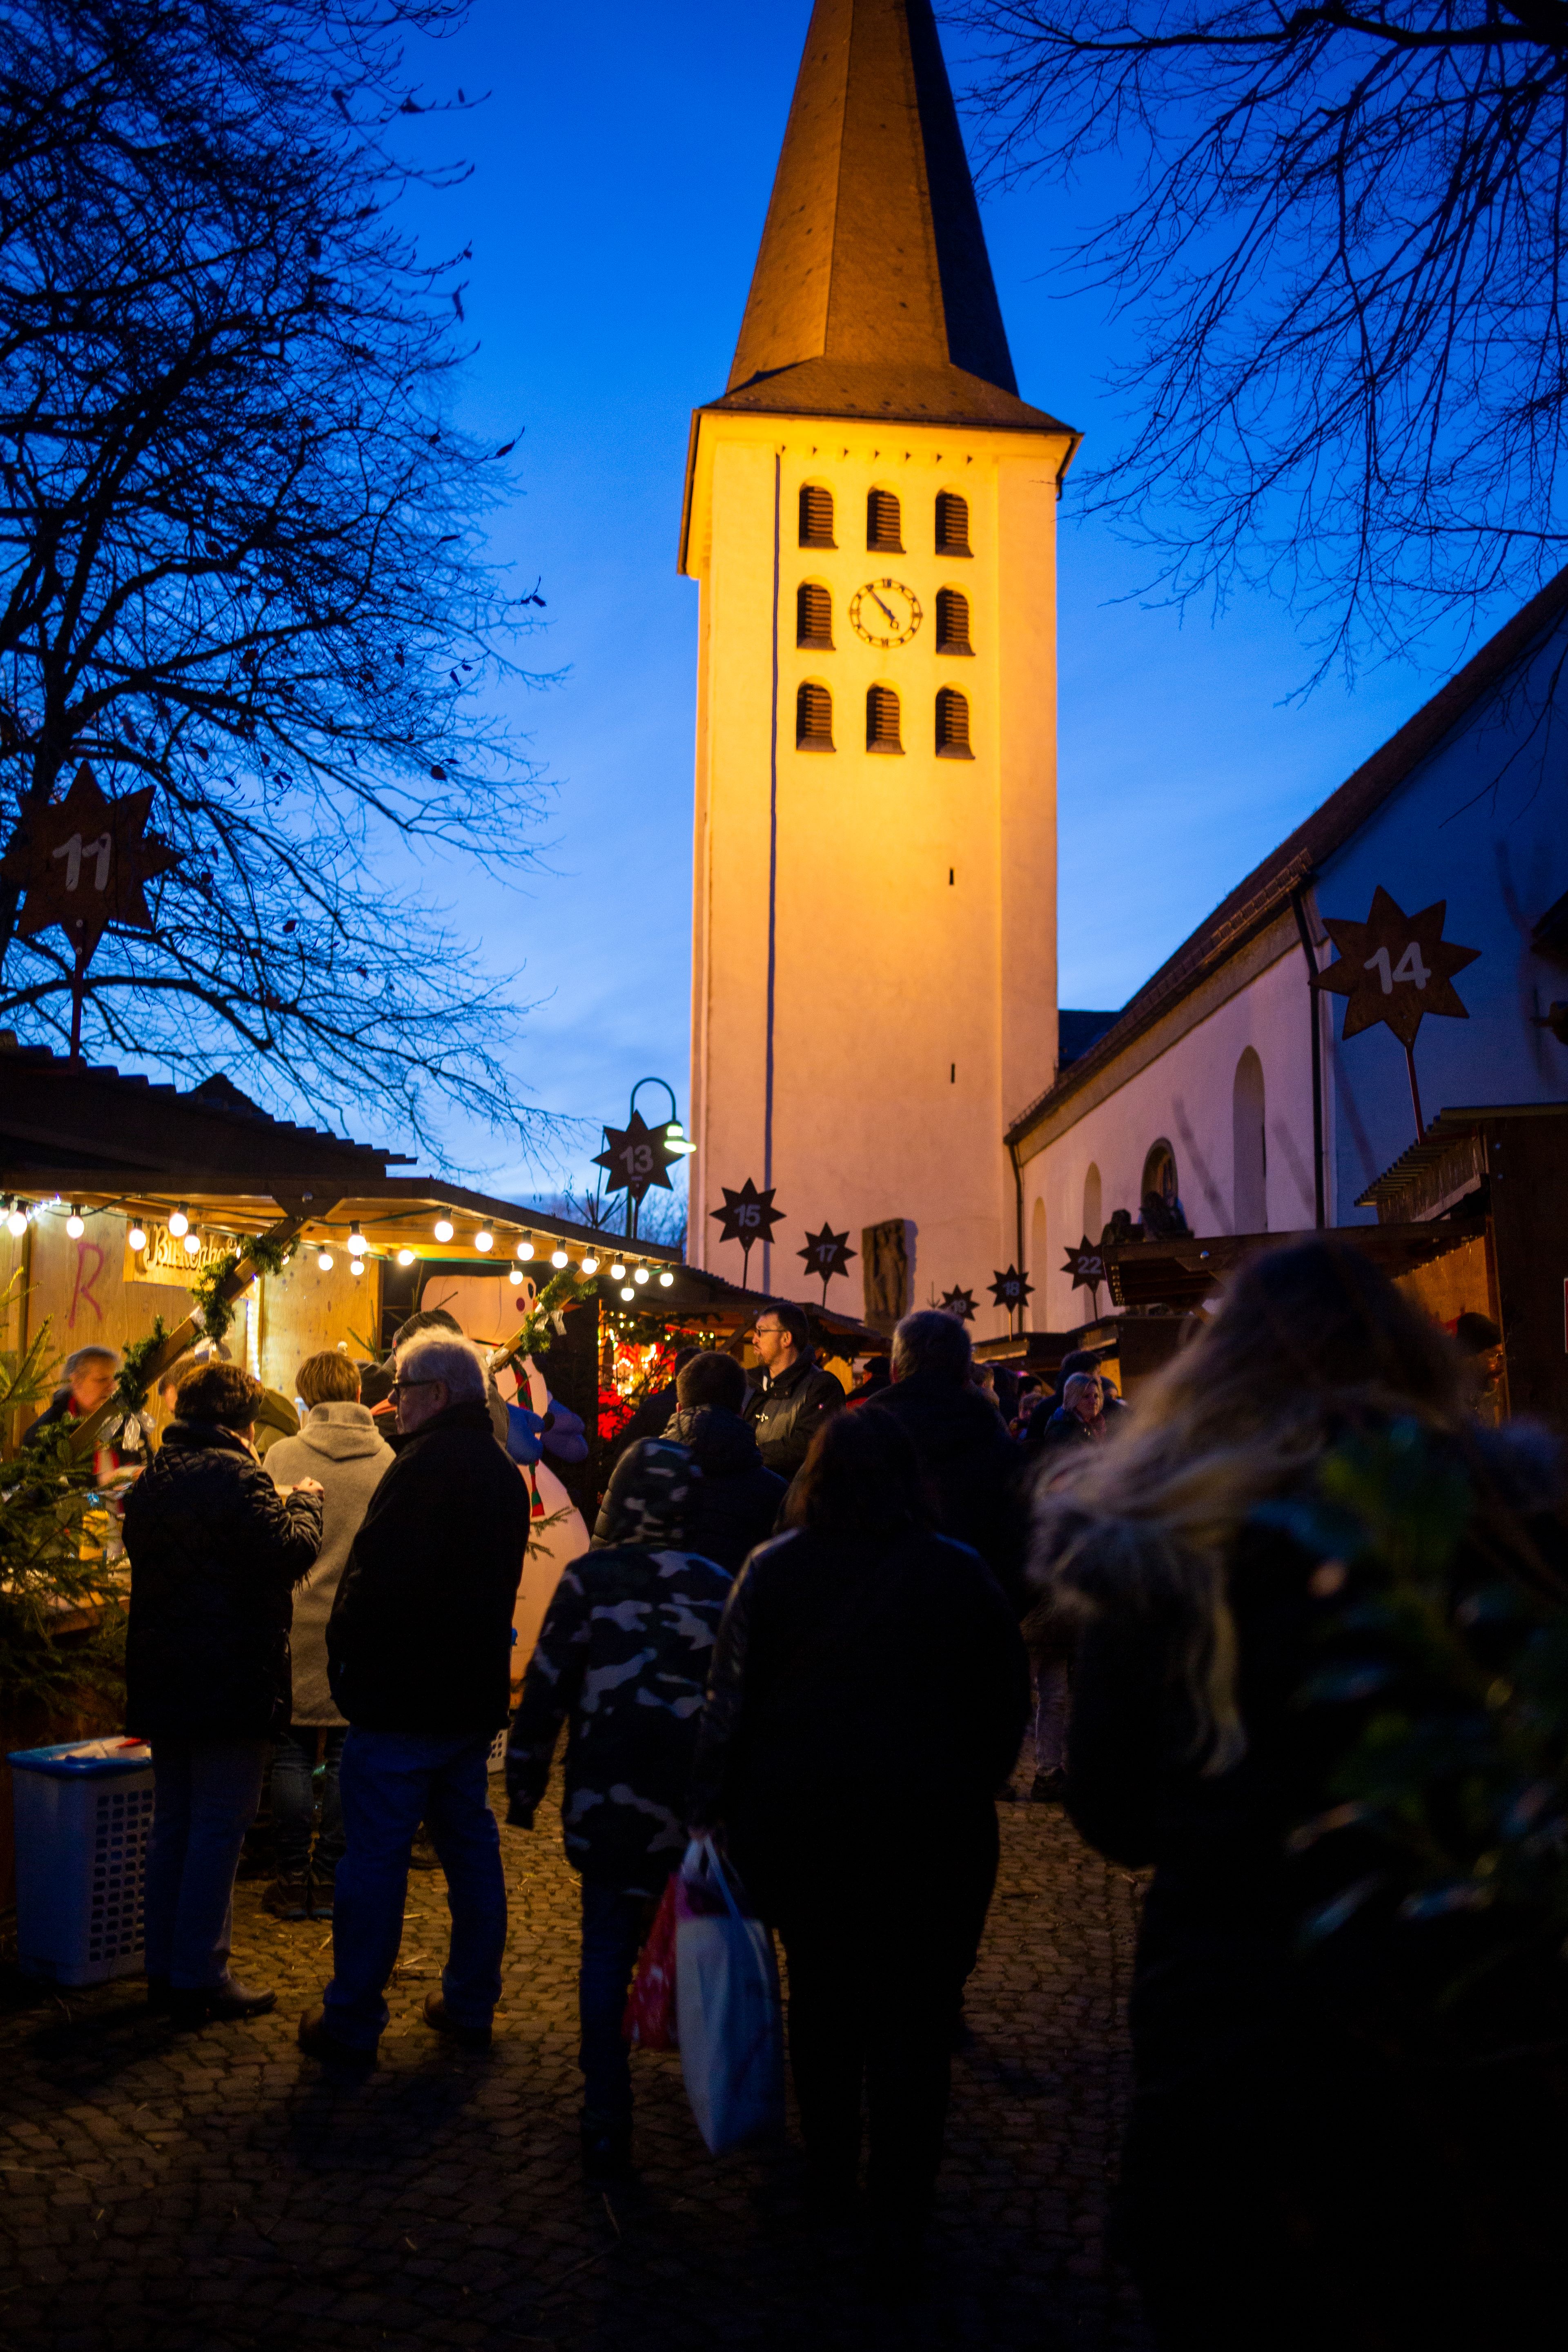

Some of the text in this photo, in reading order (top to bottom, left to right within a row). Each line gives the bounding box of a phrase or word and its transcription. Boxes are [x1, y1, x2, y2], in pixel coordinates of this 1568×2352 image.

[52, 832, 111, 891] 11
[1363, 942, 1431, 994] 14
[619, 1145, 653, 1174] 13
[734, 1204, 761, 1227] 15
[816, 1244, 838, 1263] 17
[1078, 1256, 1102, 1274] 22
[69, 1243, 104, 1328] R
[1002, 1281, 1020, 1296] 18
